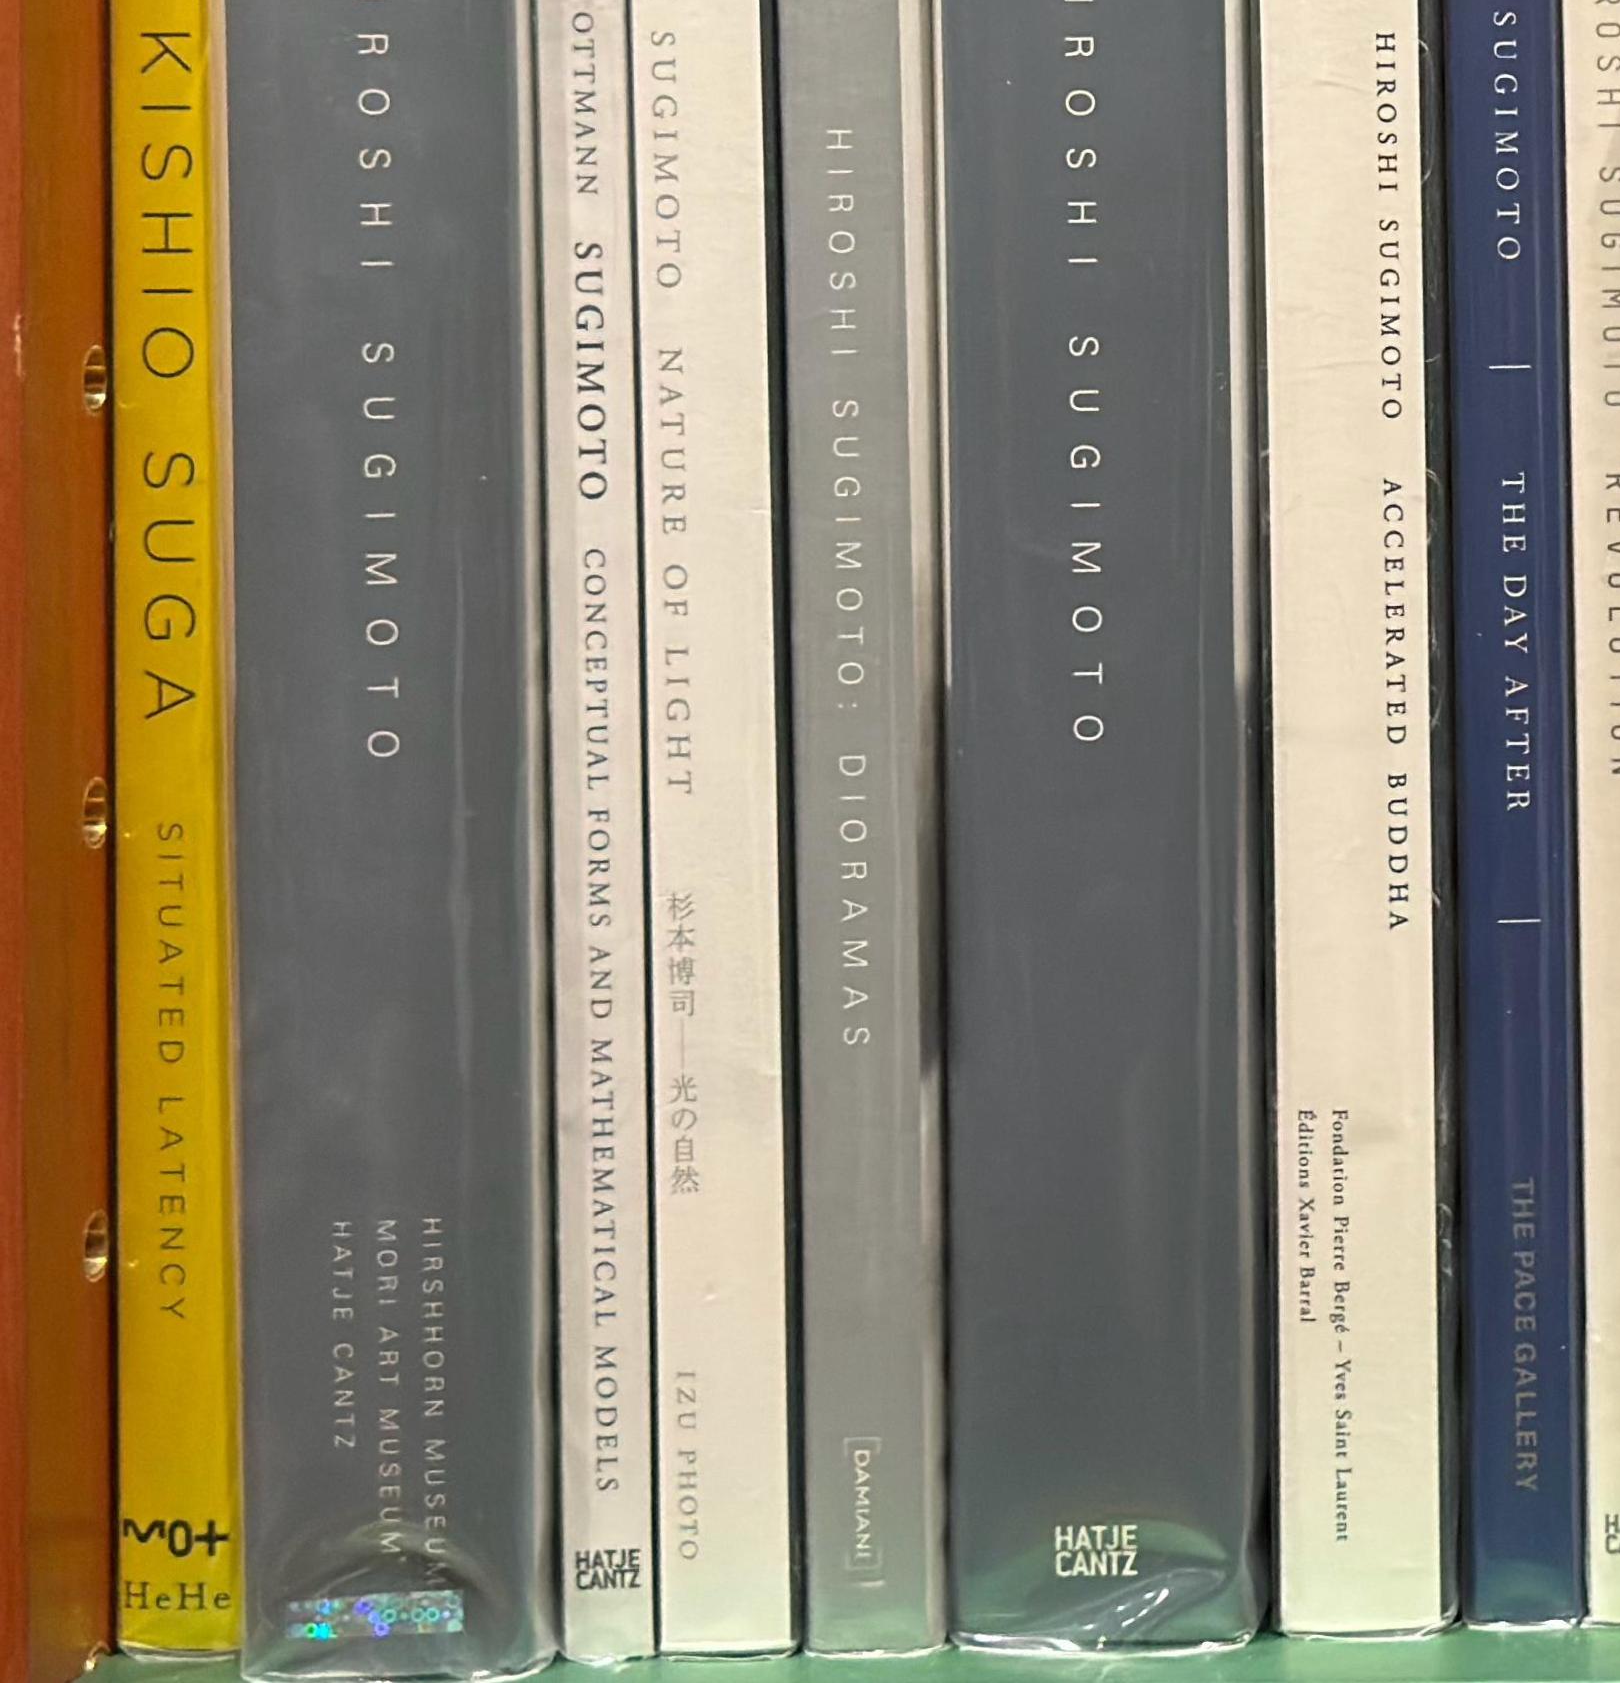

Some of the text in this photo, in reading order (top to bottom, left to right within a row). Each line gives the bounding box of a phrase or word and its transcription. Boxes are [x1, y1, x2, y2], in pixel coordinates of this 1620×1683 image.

[649, 30, 682, 290] SUGIMOTO
[140, 31, 196, 720] KISHIO SUGA
[657, 347, 687, 536] NATURE
[358, 341, 401, 759] SUGIMOTO
[569, 13, 618, 1491] OTTMANN SUGIMOTO CONCEPTUAL FORMS AND MATHEMATICAL MODELS
[662, 648, 692, 797] LIGHT
[1381, 478, 1409, 932] ACCELERATED BUDDHA
[838, 754, 871, 1046] DIORAMAS
[155, 822, 186, 1320] SITUATED LATENCY
[1297, 1109, 1320, 1323] Éditions Xavier Barral
[420, 1218, 448, 1586] HIRSHHORN MUSEUM
[674, 1368, 700, 1560] IZU PHOTO
[1328, 1108, 1354, 1543] Fondation Pierre Bergé Yves Saint Laurent
[1509, 1177, 1537, 1492] THE PACE GALLERY
[124, 1580, 232, 1611] HeHe
[1054, 1525, 1138, 1551] HATJE
[1054, 1552, 1138, 1577] CANTZ
